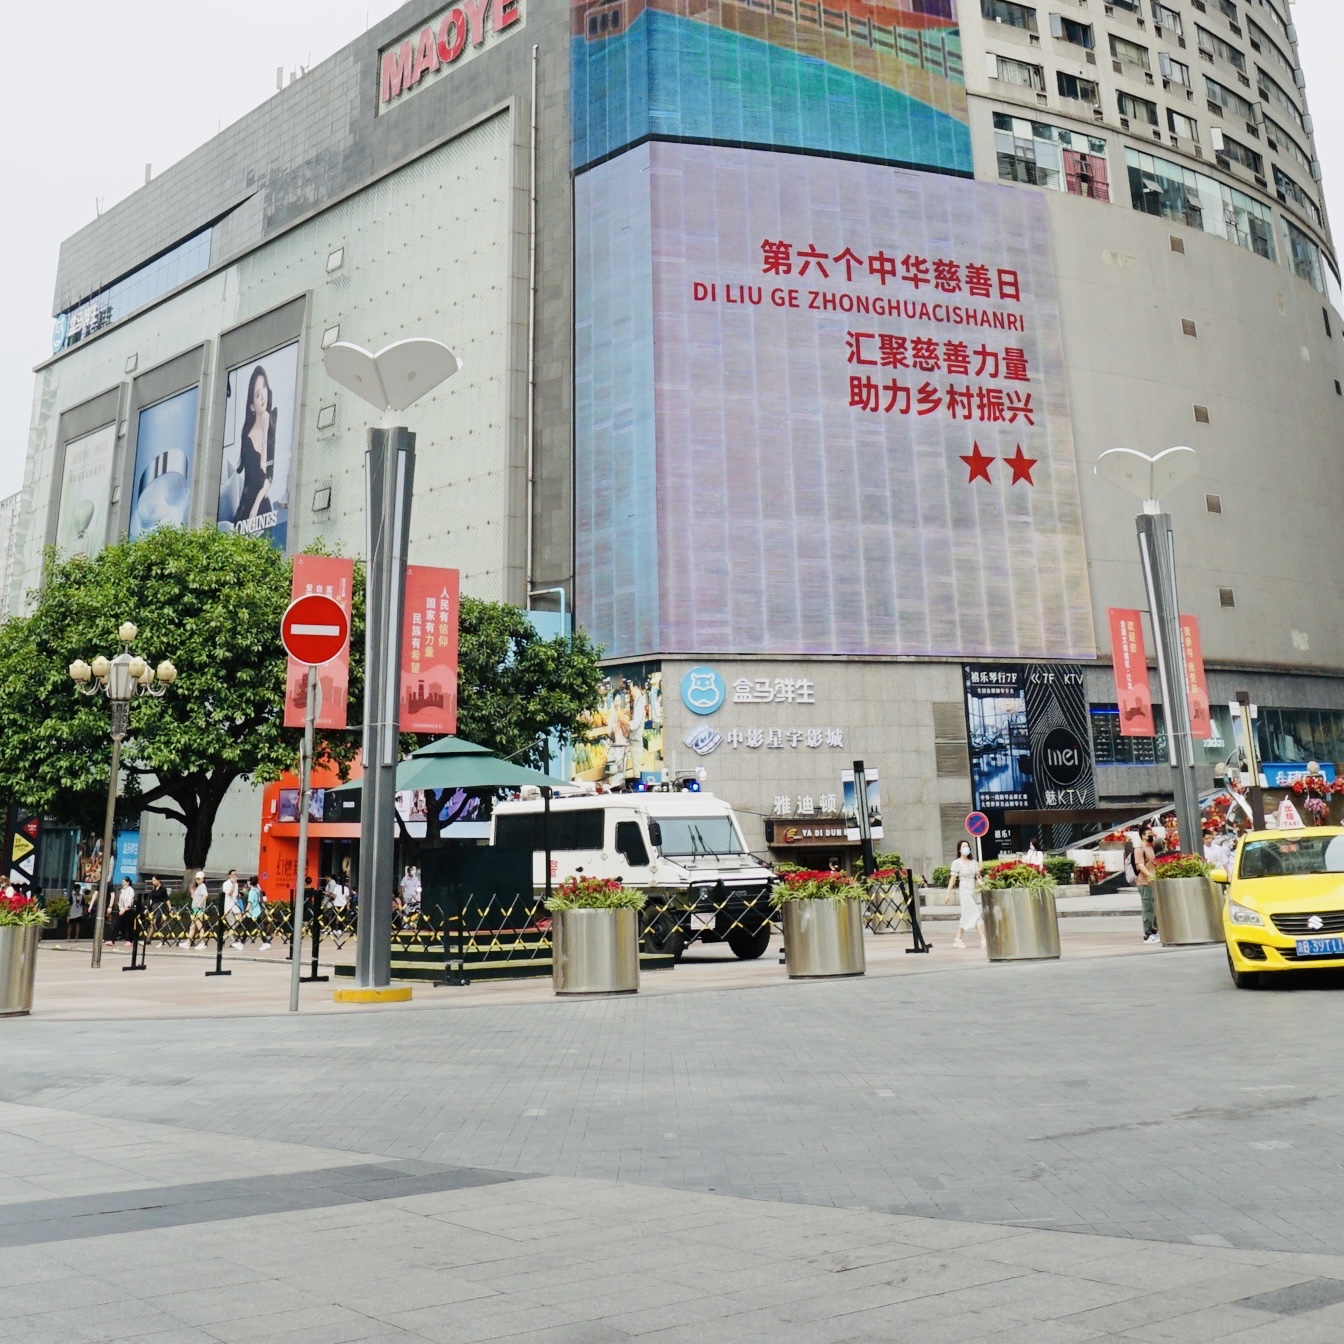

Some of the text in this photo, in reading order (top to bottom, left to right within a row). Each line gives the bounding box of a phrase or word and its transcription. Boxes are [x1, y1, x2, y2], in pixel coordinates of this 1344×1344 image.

[762, 238, 1022, 303] 第六个中华慈善日
[693, 281, 1026, 333] DI LIU GE ZHONGHUACISHANRI
[846, 331, 1030, 383] 汇聚慈善力量
[848, 376, 1035, 427] 助力乡村振兴
[231, 510, 278, 536] LONGINES
[425, 597, 436, 658] 国家有力量
[438, 587, 449, 647] 人民有信仰
[410, 613, 422, 674] 民族有希望
[732, 677, 816, 704] 盒马鲜生
[1043, 673, 1084, 685] 7F KTV
[774, 793, 857, 818] 雅迪顿
[1045, 790, 1089, 806] 魅KTV
[1284, 805, 1295, 821] 出租
